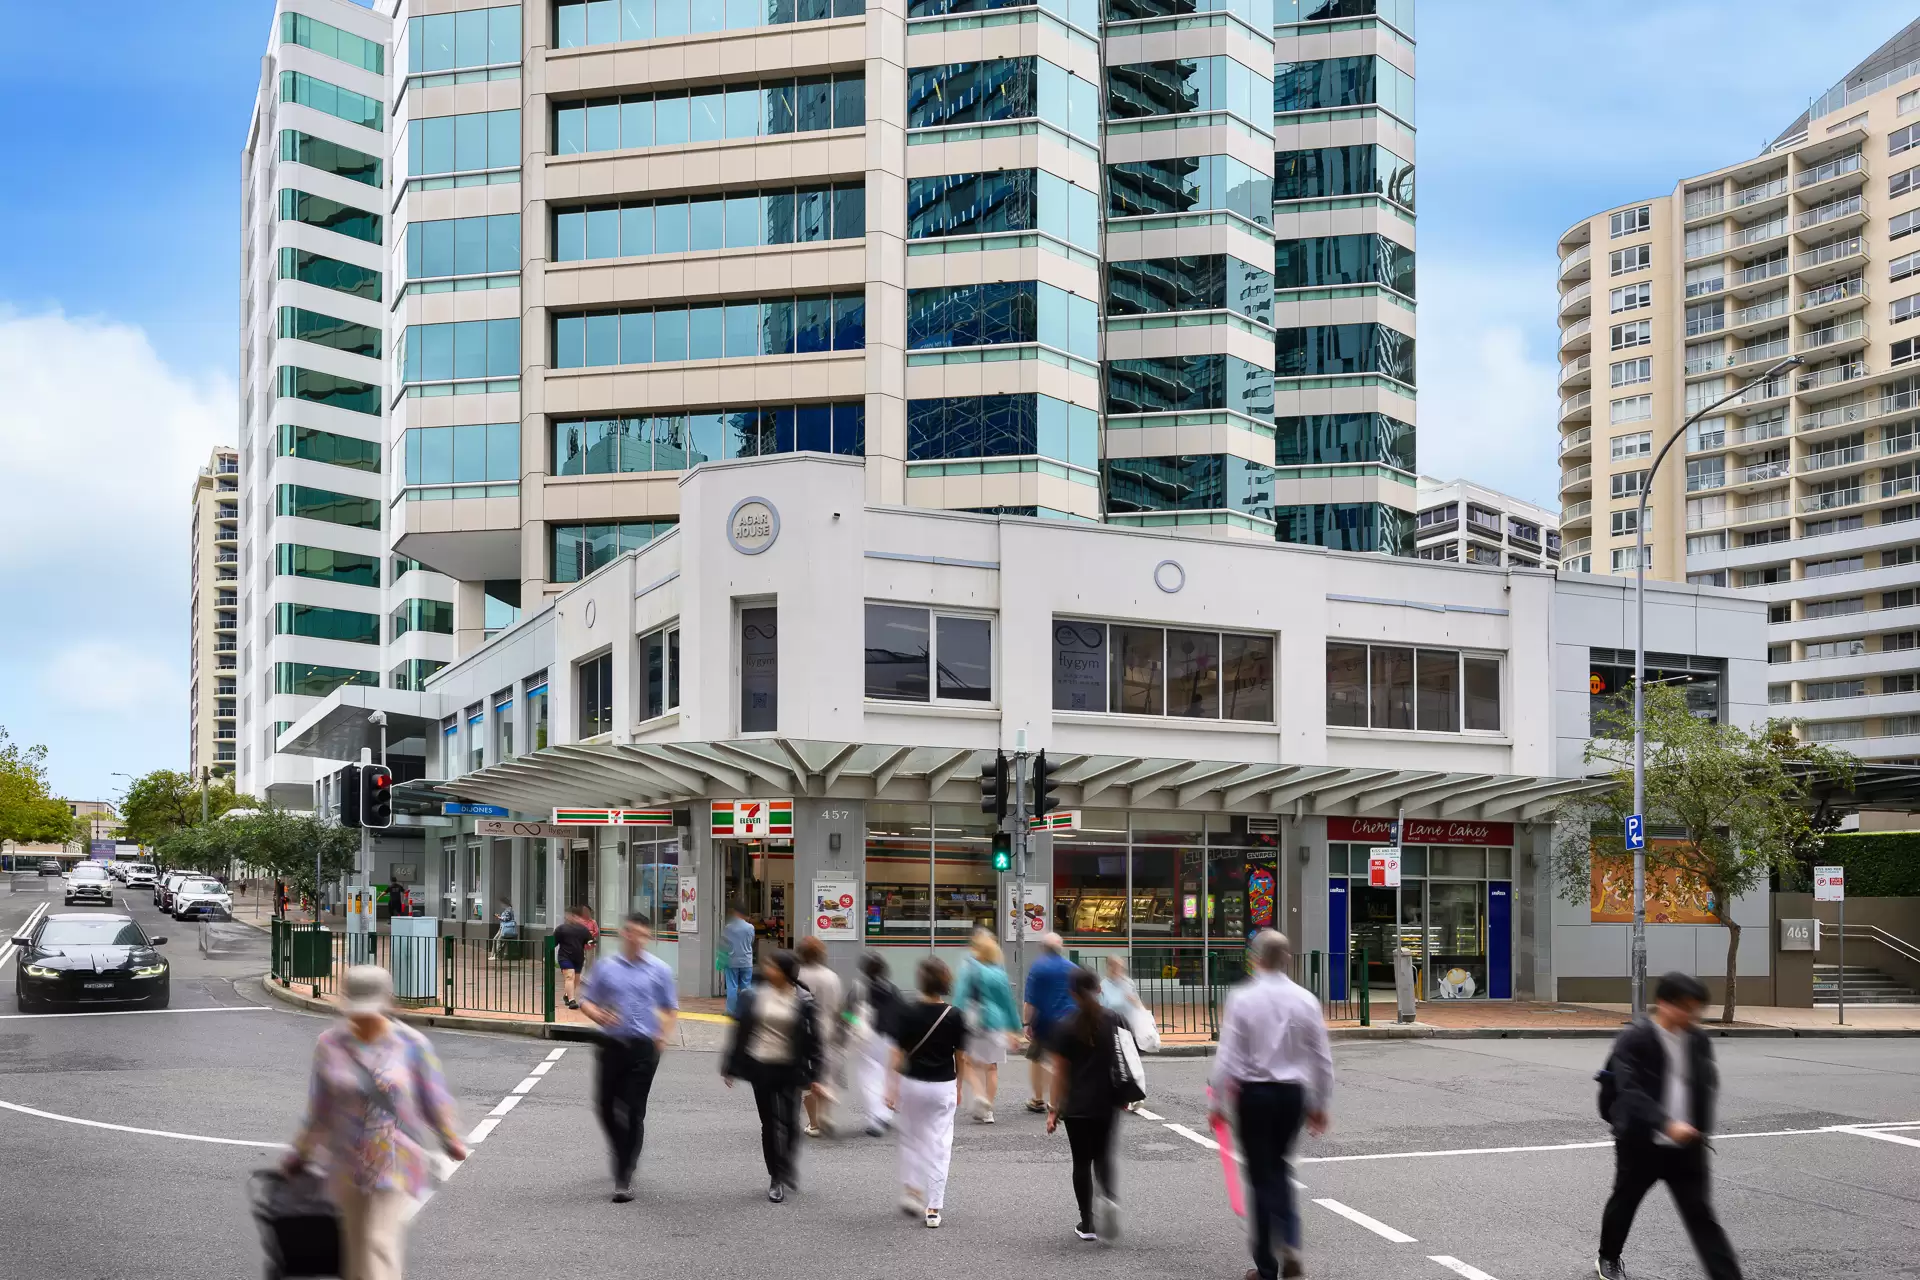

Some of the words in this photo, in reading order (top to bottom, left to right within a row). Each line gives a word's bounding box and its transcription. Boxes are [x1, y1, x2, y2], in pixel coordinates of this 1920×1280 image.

[738, 512, 768, 526] AGAR
[735, 525, 770, 539] HOUSE
[740, 803, 760, 833] 7
[821, 810, 849, 820] 457
[1352, 819, 1404, 834] Cherr
[1409, 822, 1444, 837] Lane
[1448, 822, 1489, 838] Cakes
[1629, 818, 1638, 836] P
[1787, 927, 1809, 939] 465
